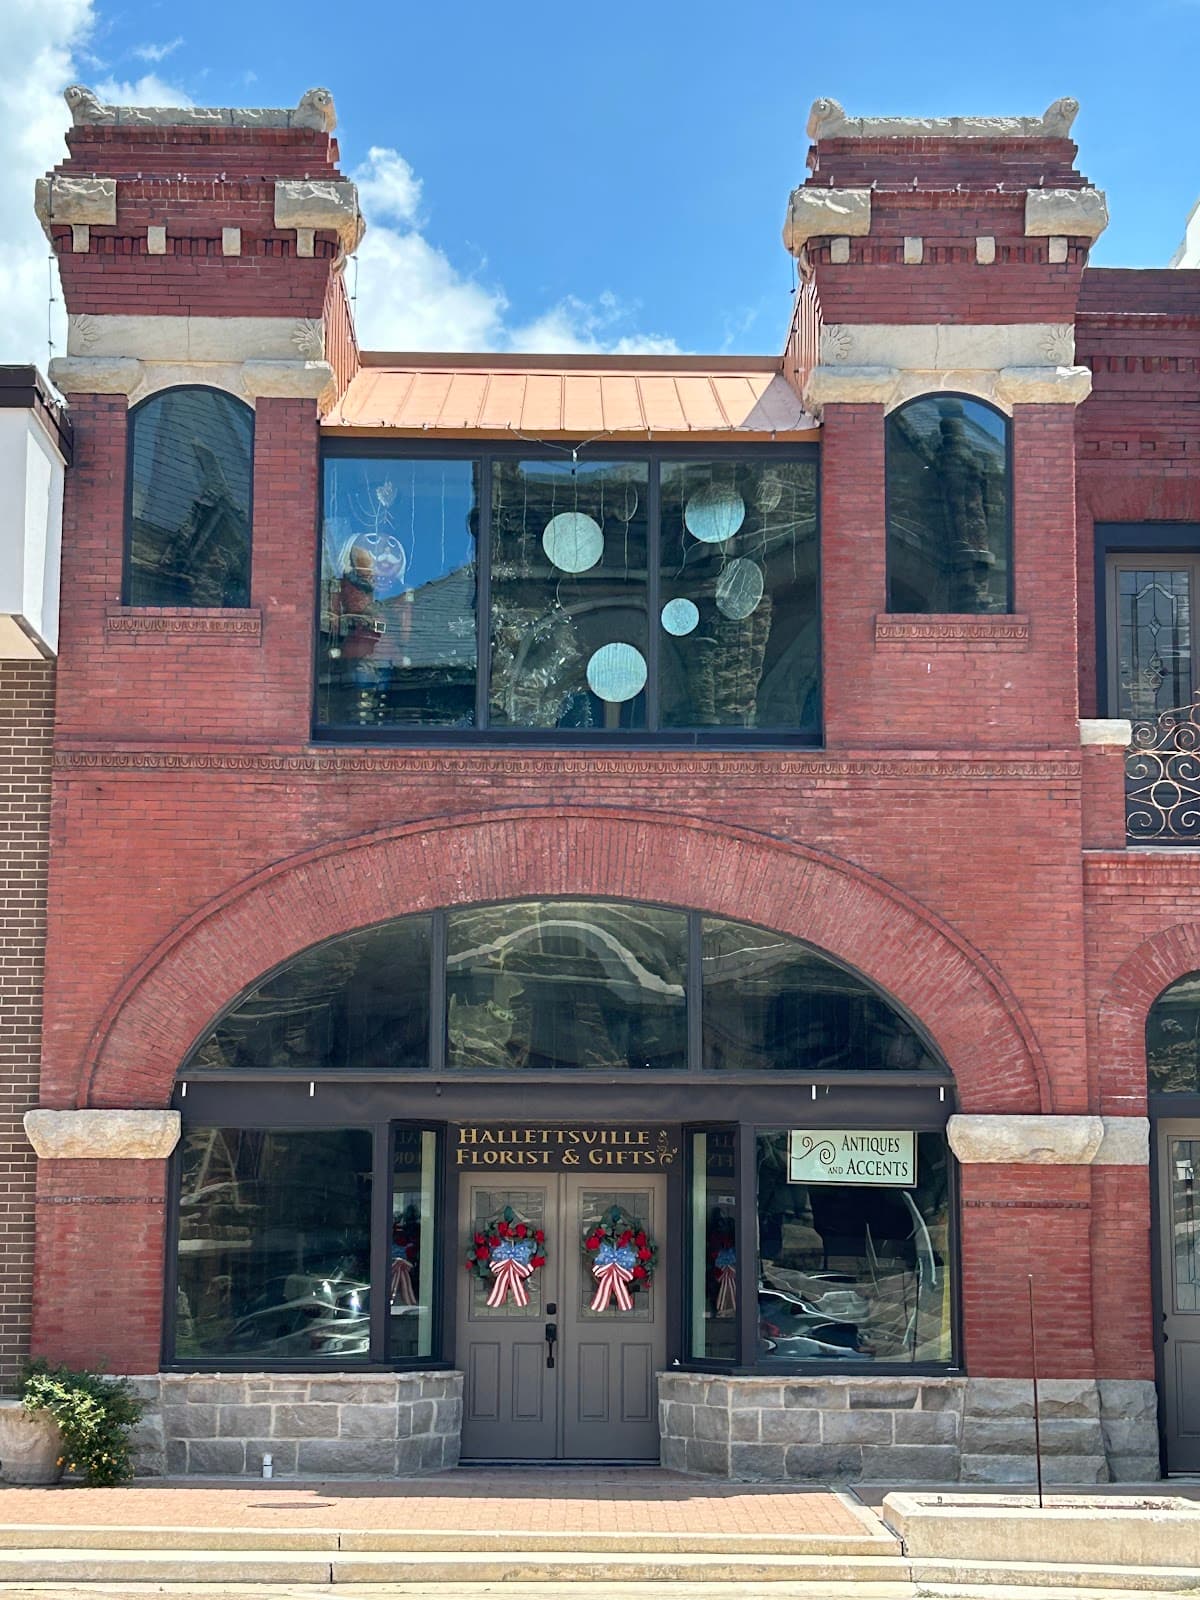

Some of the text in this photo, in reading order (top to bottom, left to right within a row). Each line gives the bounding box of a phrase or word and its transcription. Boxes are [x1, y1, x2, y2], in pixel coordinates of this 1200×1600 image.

[458, 1128, 650, 1145] HALLETTSVILLE
[841, 1134, 901, 1156] ANTIQUES
[456, 1148, 656, 1165] FLORIST & GIFTS
[827, 1158, 909, 1177] AND ACCENTS
